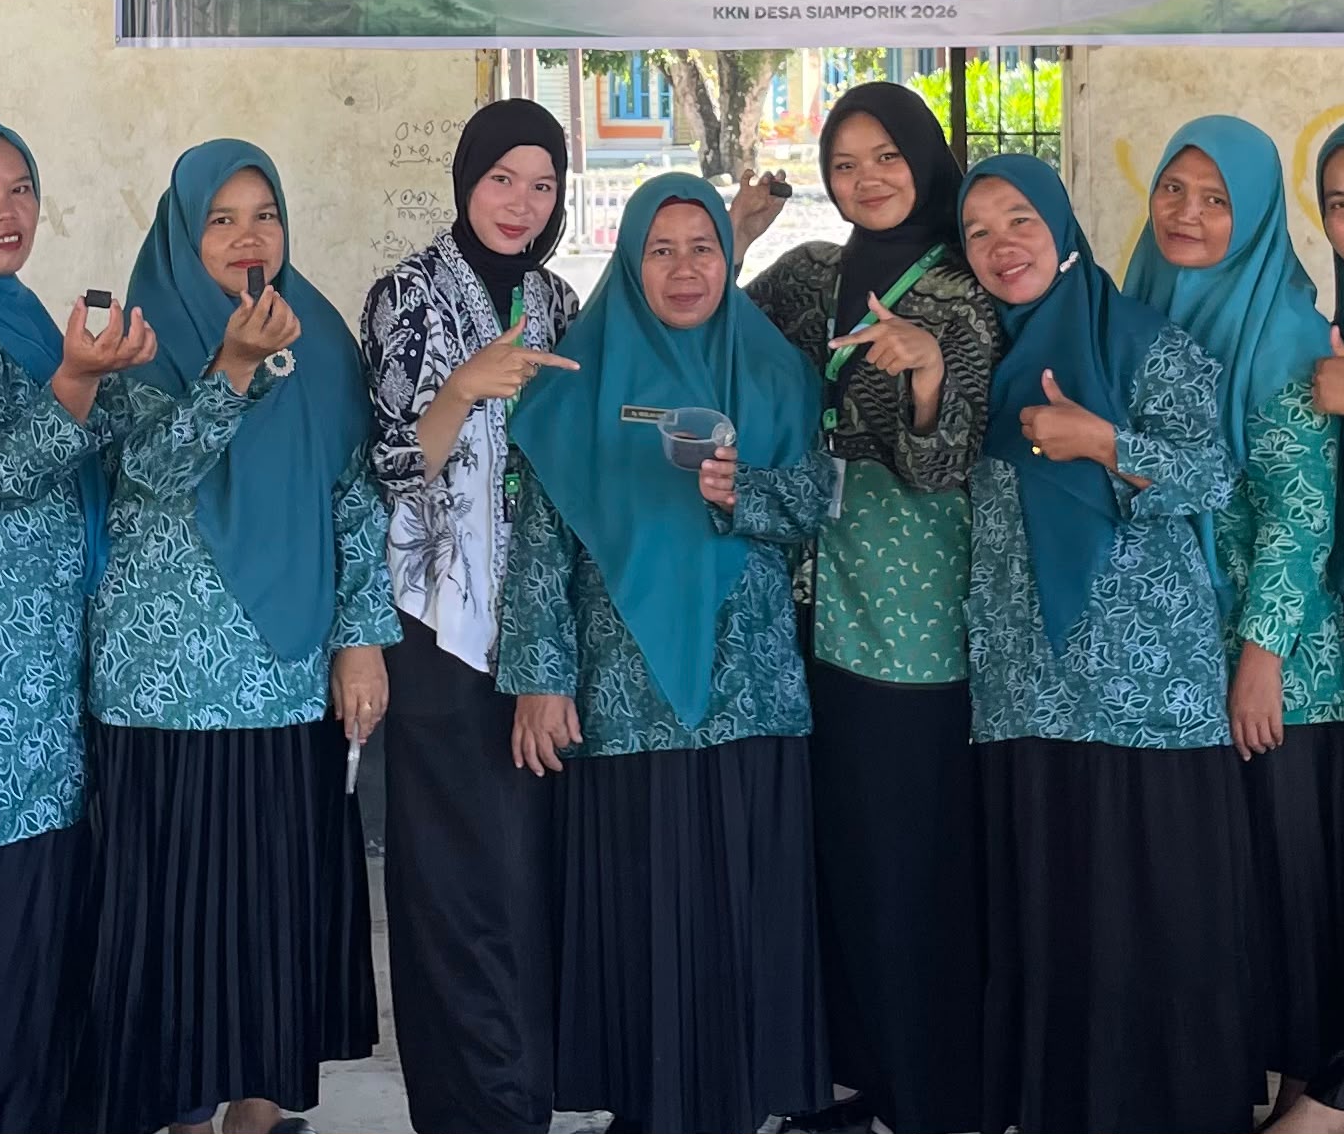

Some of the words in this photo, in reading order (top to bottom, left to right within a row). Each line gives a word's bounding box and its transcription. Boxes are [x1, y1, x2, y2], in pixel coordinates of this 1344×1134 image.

[712, 6, 750, 19] KKN
[755, 6, 802, 19] DESA
[806, 5, 907, 19] SIAMPORIK
[911, 4, 958, 19] 2026
